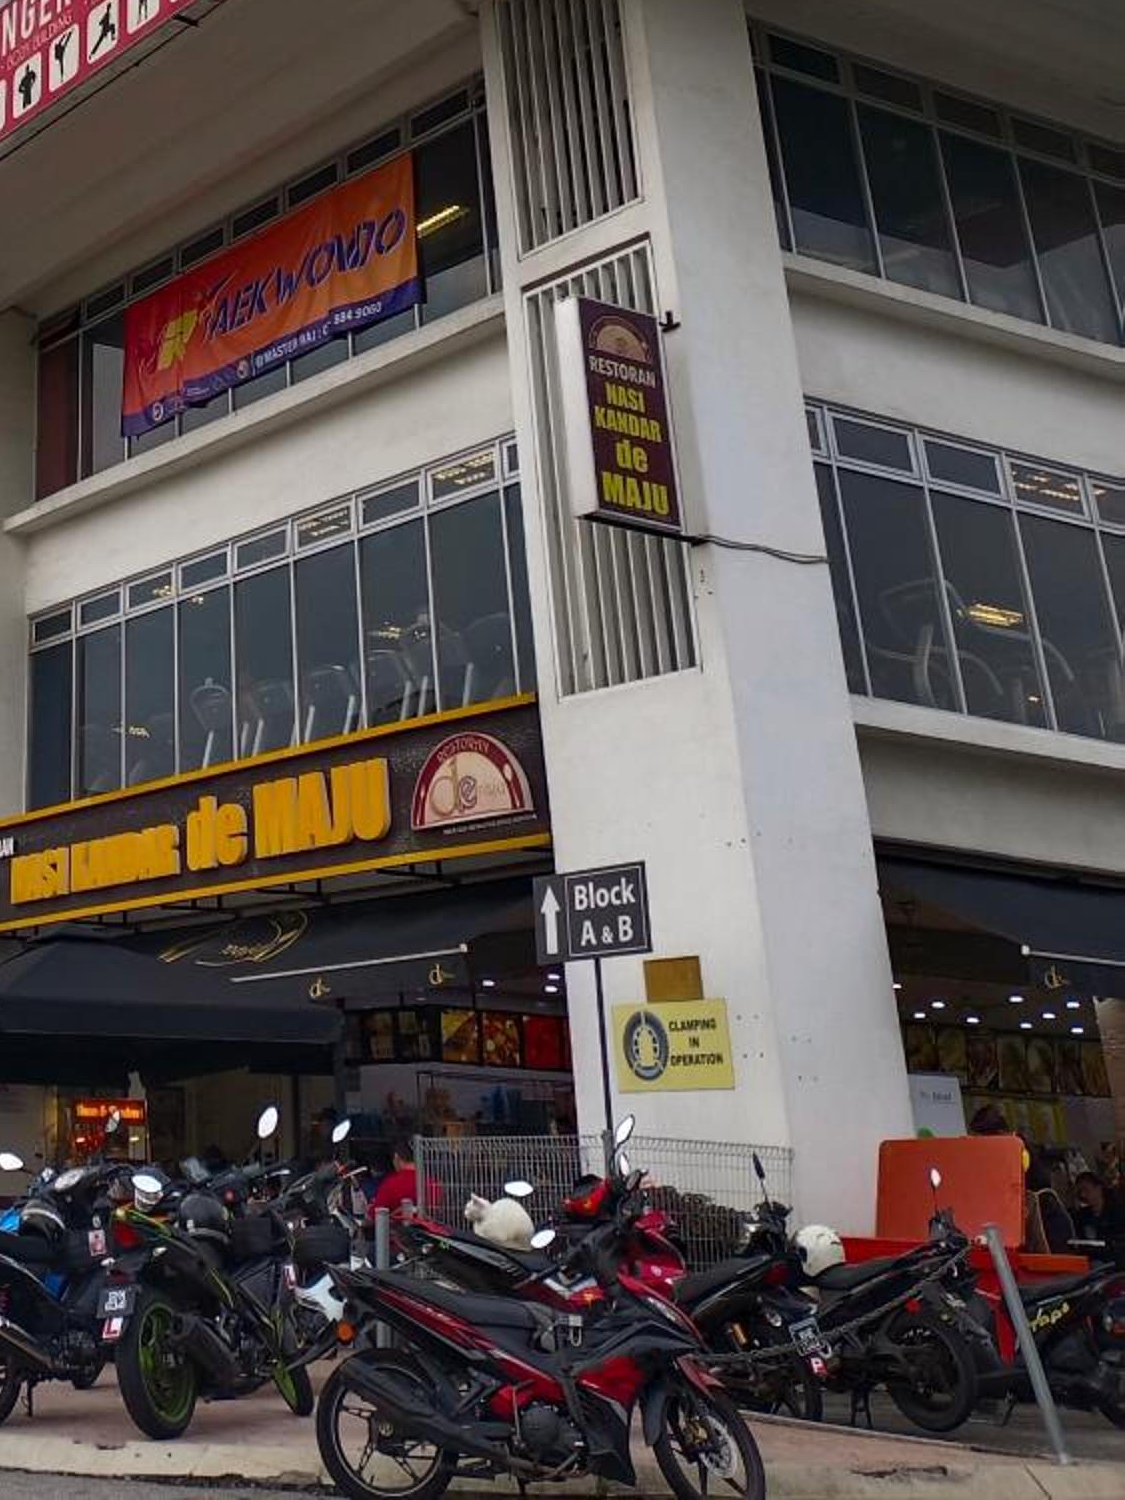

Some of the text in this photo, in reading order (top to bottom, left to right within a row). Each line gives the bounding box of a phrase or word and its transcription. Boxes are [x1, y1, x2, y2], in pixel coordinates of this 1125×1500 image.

[589, 355, 656, 389] RESTORAN
[605, 382, 645, 413] NASI
[594, 406, 662, 442] KANDAR
[615, 439, 649, 473] de
[602, 472, 669, 515] MAJU
[10, 846, 70, 904] NASI
[186, 795, 248, 872] de
[253, 757, 391, 859] MAJU
[574, 877, 635, 911] Block
[580, 915, 634, 946] A & B
[669, 1018, 717, 1031] CLAMPING
[670, 1052, 724, 1067] OPERATION
[688, 1036, 700, 1049] IN
